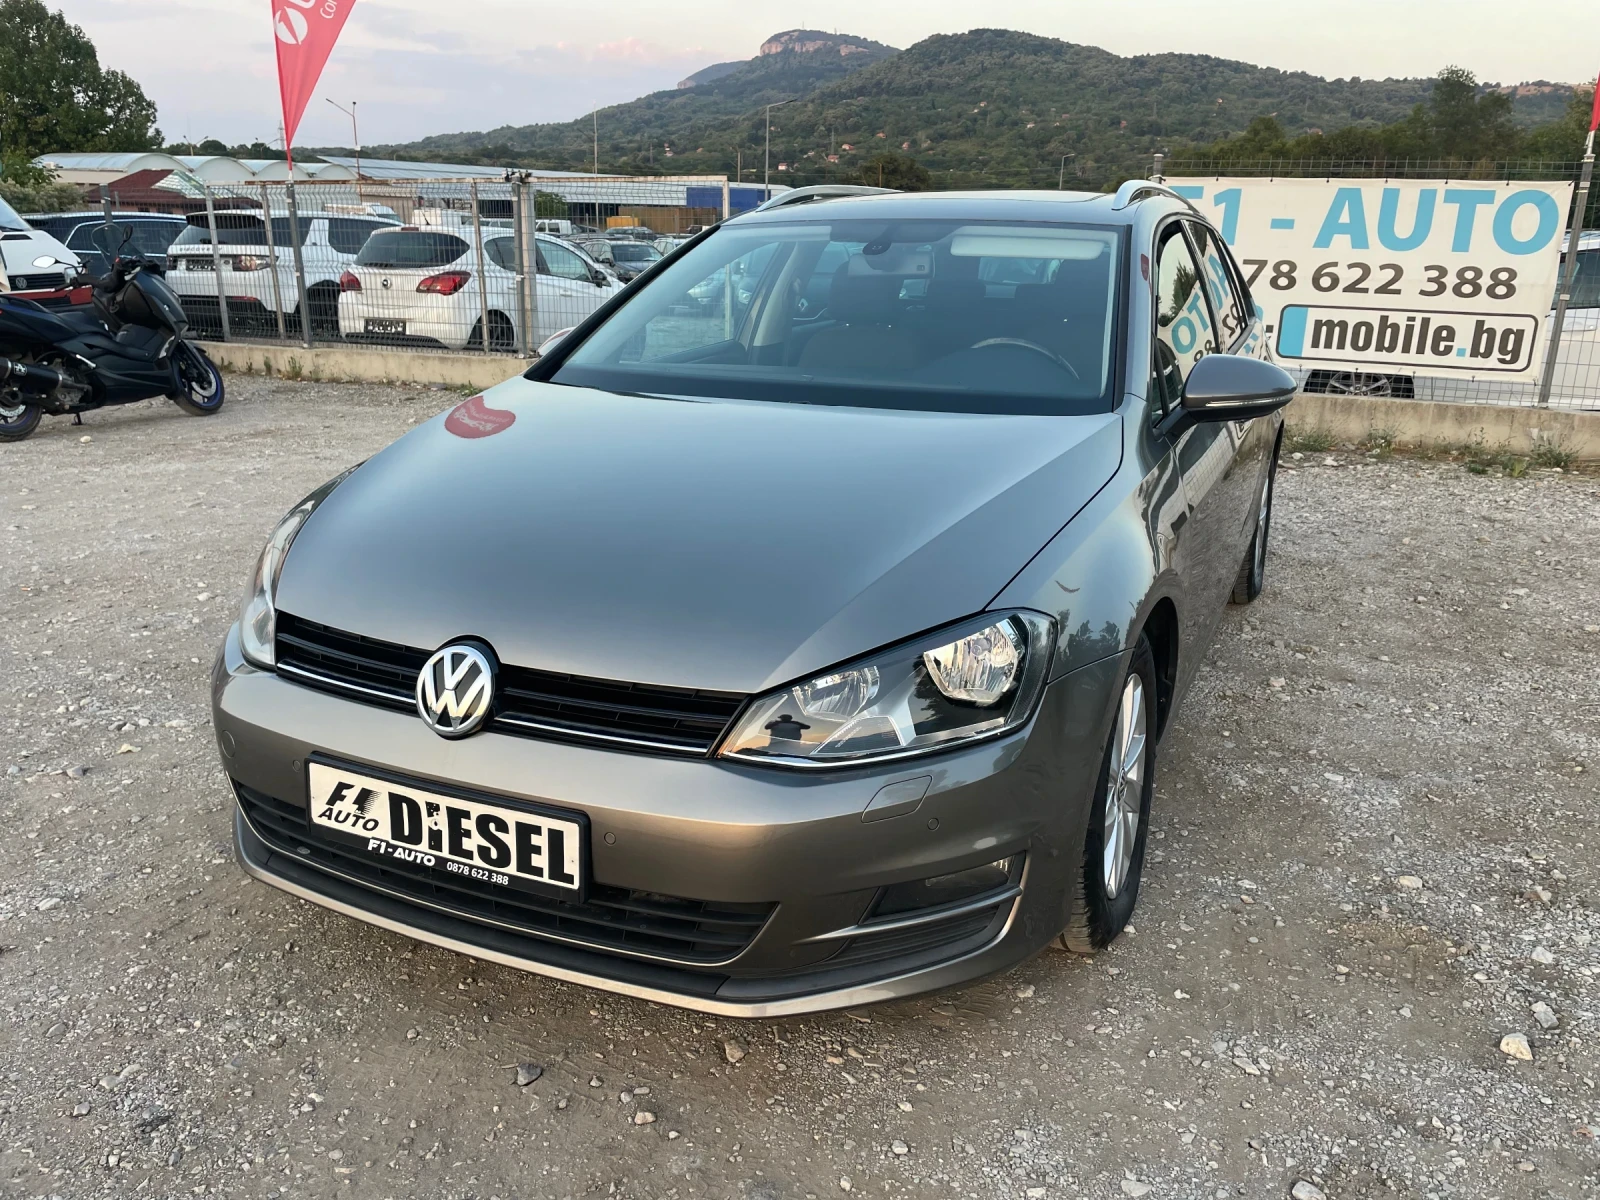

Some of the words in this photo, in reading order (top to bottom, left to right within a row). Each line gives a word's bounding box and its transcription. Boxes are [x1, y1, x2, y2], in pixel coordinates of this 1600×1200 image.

[1313, 187, 1560, 255] AUTO
[1311, 262, 1404, 295] 622
[1419, 264, 1518, 300] 388
[1310, 314, 1526, 365] mobile.bg
[318, 807, 379, 831] AUTO
[325, 781, 382, 815] F1
[367, 839, 435, 867] F1-AUTO
[446, 862, 470, 876] 0878
[471, 868, 489, 881] 622
[490, 873, 509, 886] 388
